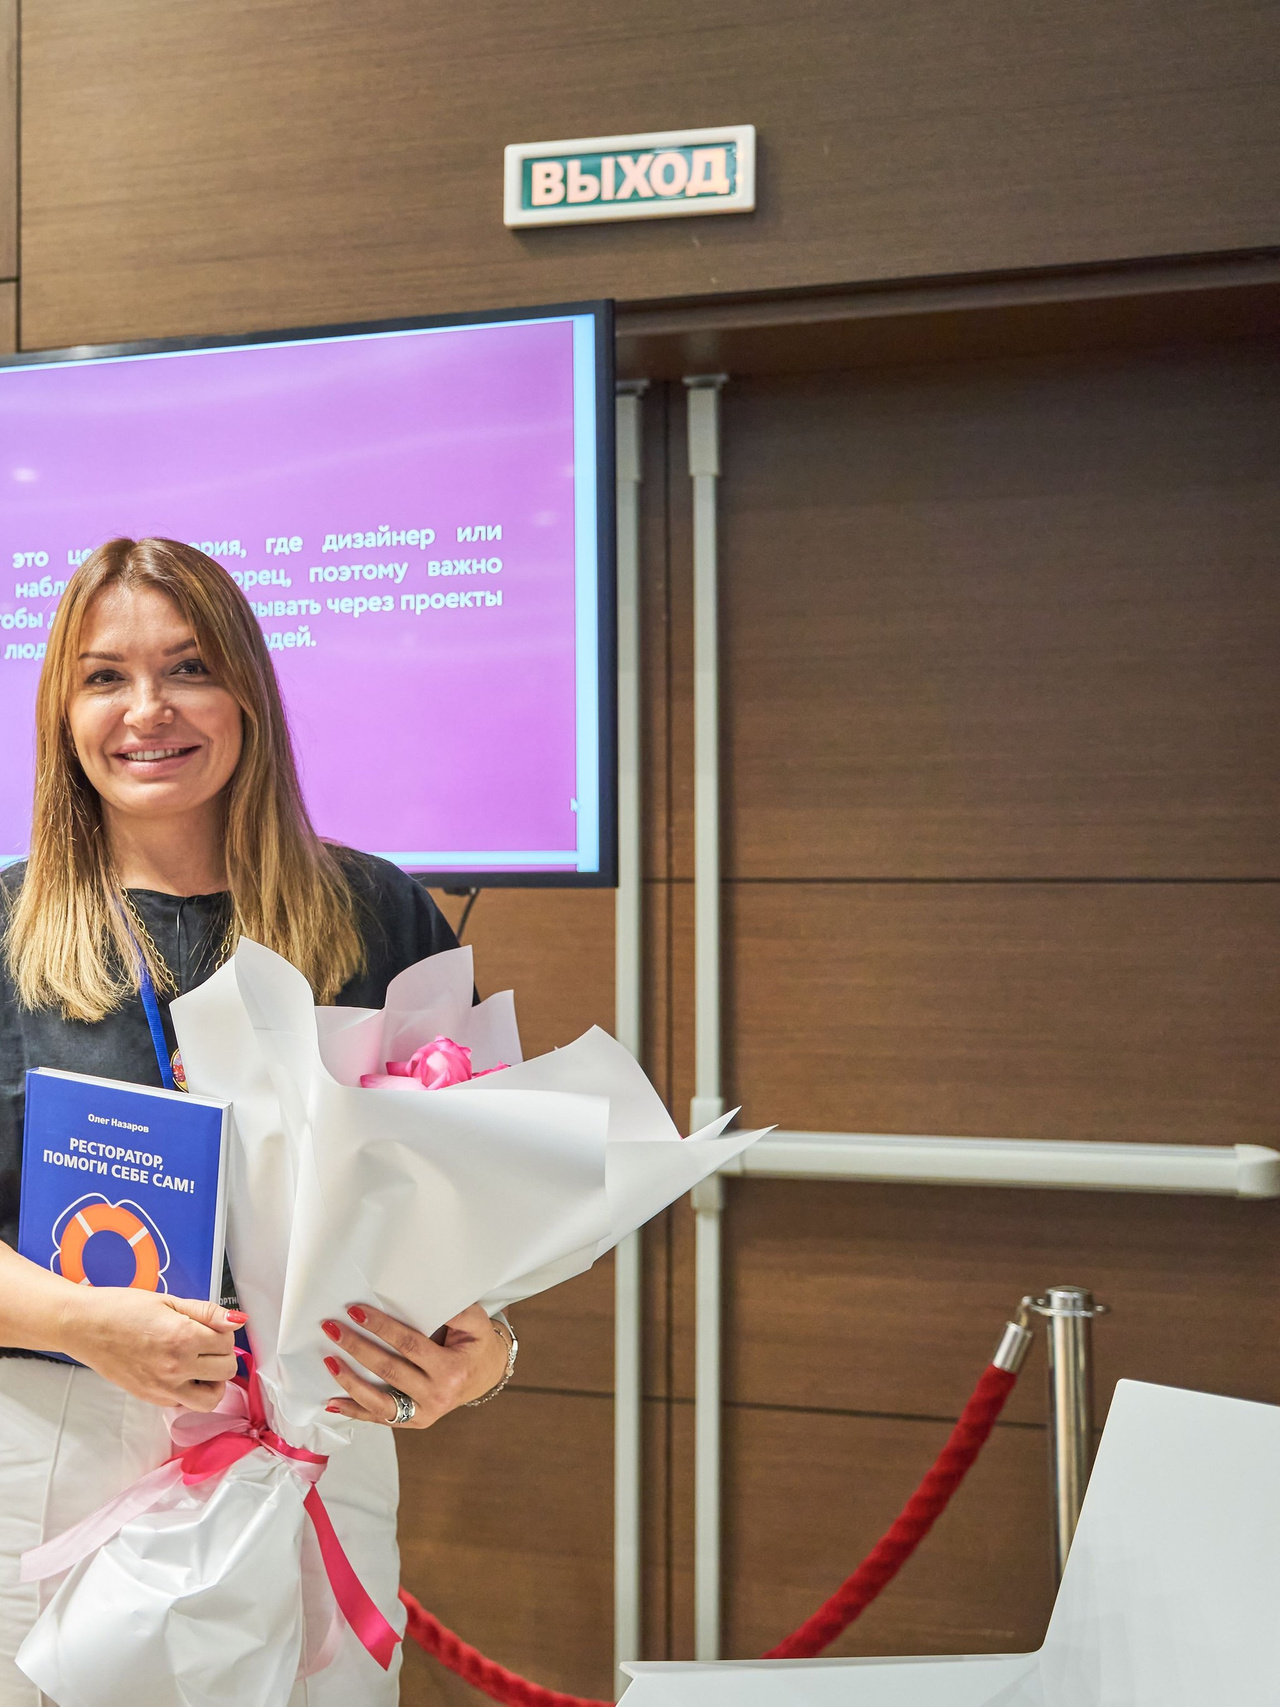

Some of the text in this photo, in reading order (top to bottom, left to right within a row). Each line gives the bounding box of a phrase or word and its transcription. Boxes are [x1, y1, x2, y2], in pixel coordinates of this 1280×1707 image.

[531, 147, 730, 206] ВЫХОД
[12, 550, 49, 569] это
[265, 536, 303, 556] где
[322, 525, 436, 553] дизайнер
[456, 524, 503, 544] или
[15, 575, 68, 599] набл
[230, 568, 292, 591] орец,
[308, 561, 409, 584] поэтому
[427, 556, 503, 577] важно
[249, 599, 323, 618] ывать
[326, 594, 395, 618] через
[400, 590, 503, 616] проекты
[4, 642, 48, 662] люд
[263, 625, 318, 652] дей.
[87, 1112, 150, 1134] Олег Назаров
[42, 1148, 196, 1194] ПОМОГИ СЕБЕ САМ!
[69, 1136, 164, 1172] РЕСТОРАТОР,
